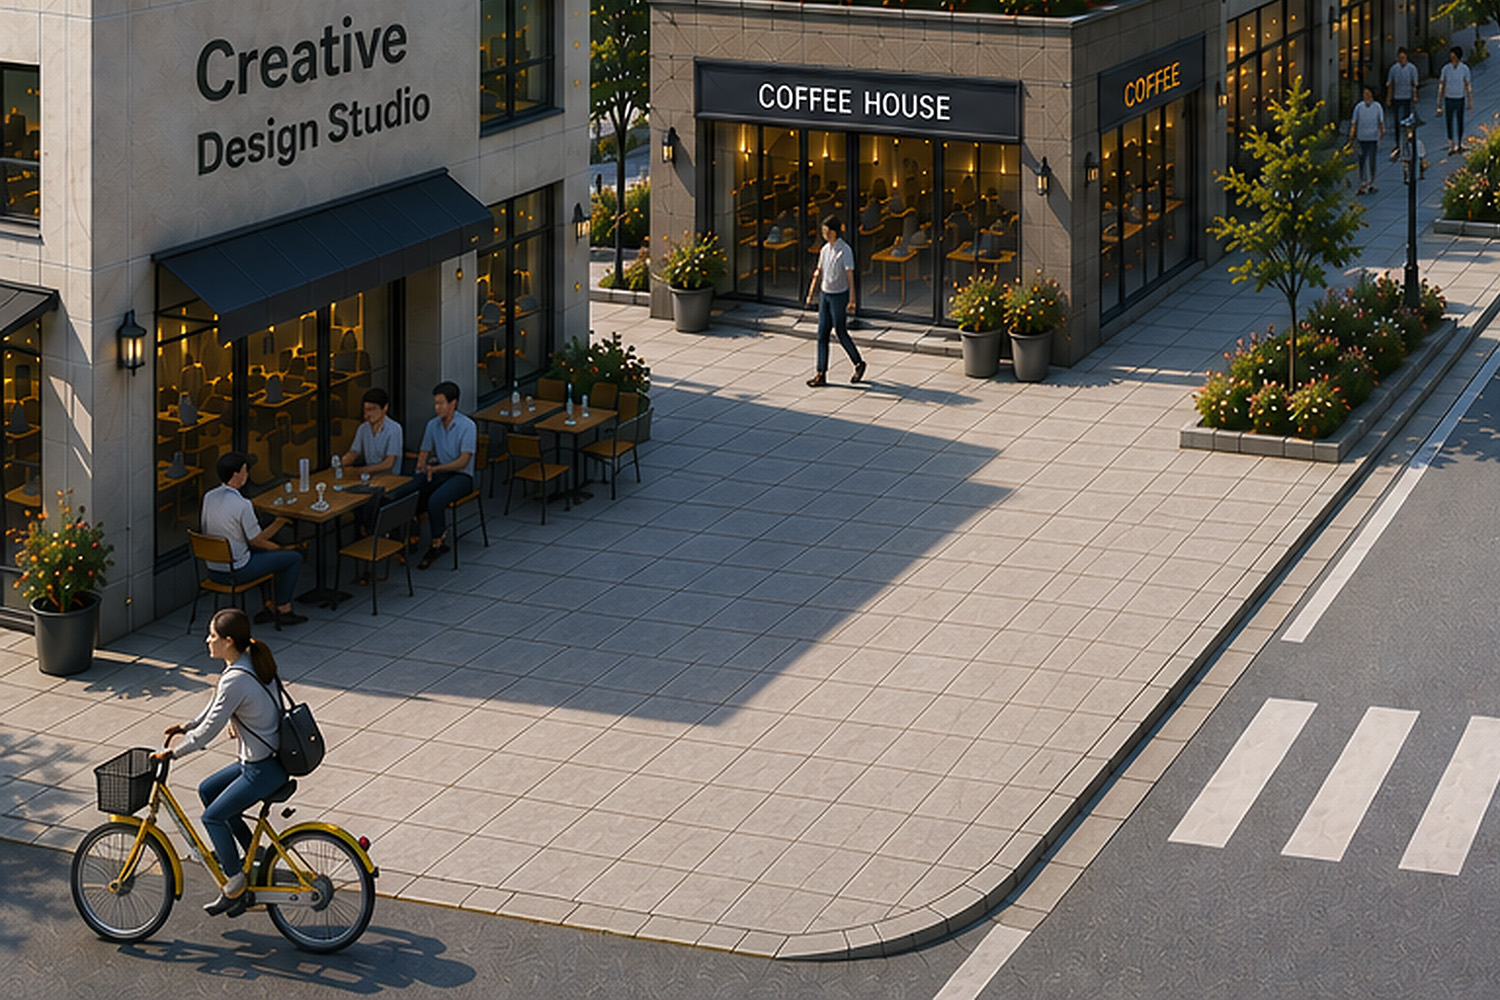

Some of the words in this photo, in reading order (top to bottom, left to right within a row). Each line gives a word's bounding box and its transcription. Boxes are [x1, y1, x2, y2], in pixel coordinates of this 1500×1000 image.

[196, 15, 407, 101] Creative
[1124, 61, 1181, 108] COFFEE
[197, 116, 319, 177] Design
[327, 85, 431, 144] Studio
[758, 83, 852, 114] COFFEE
[864, 90, 951, 121] HOUSE
